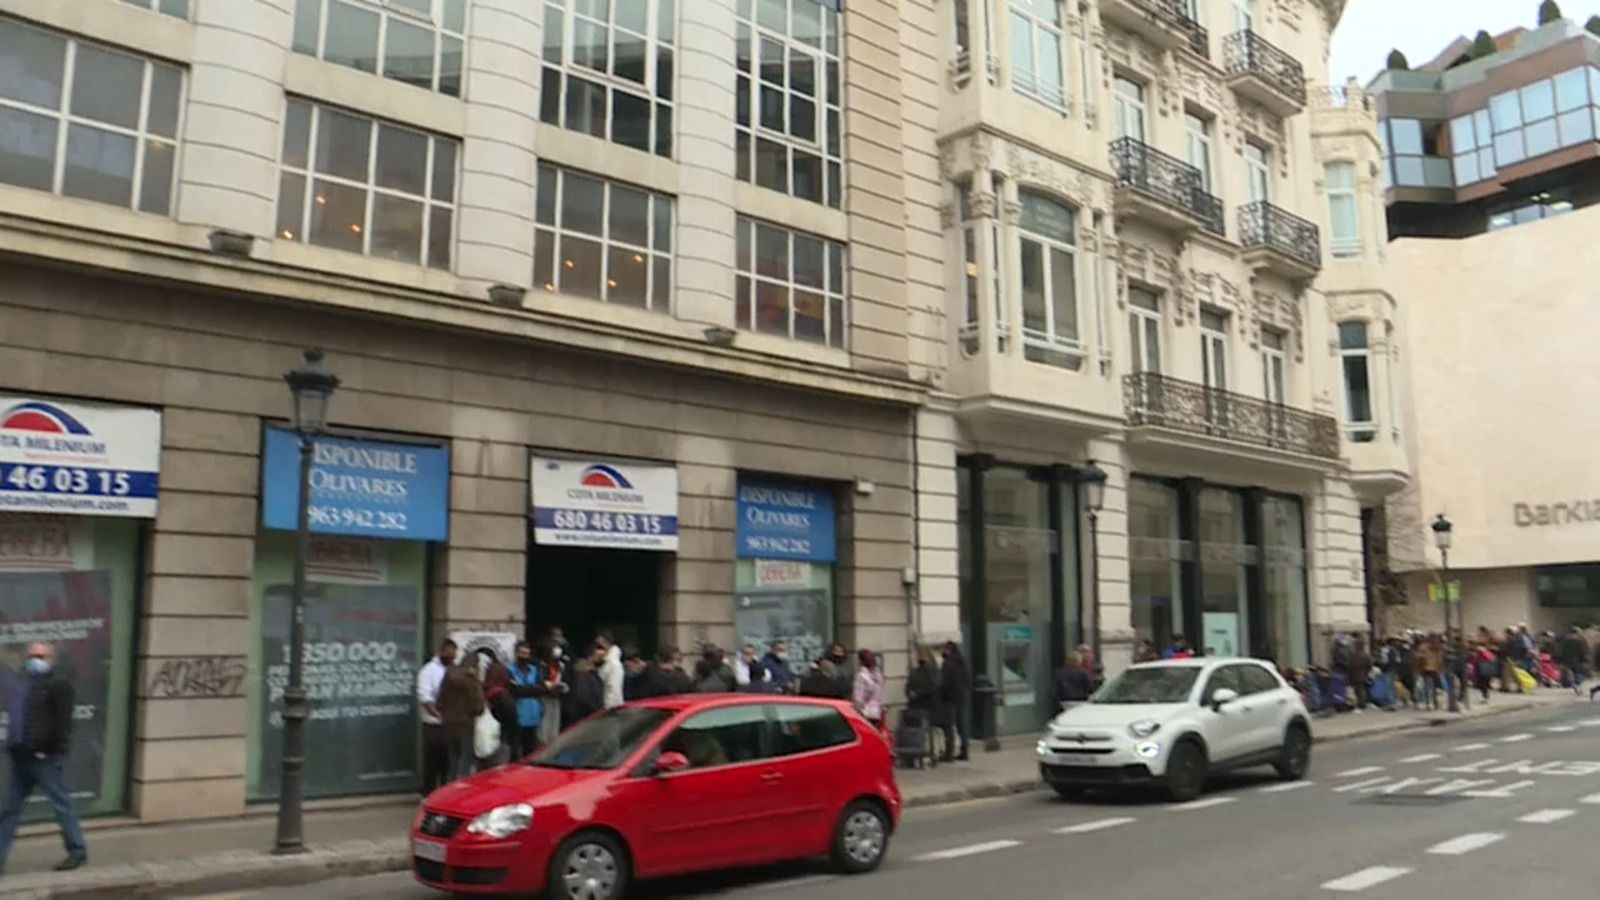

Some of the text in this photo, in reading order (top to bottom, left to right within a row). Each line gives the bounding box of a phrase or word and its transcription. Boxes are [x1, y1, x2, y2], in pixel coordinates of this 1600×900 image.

[8, 466, 131, 496] 46 03 15
[308, 468, 408, 497] OLIVARES
[553, 511, 662, 534] 680 46 03 15
